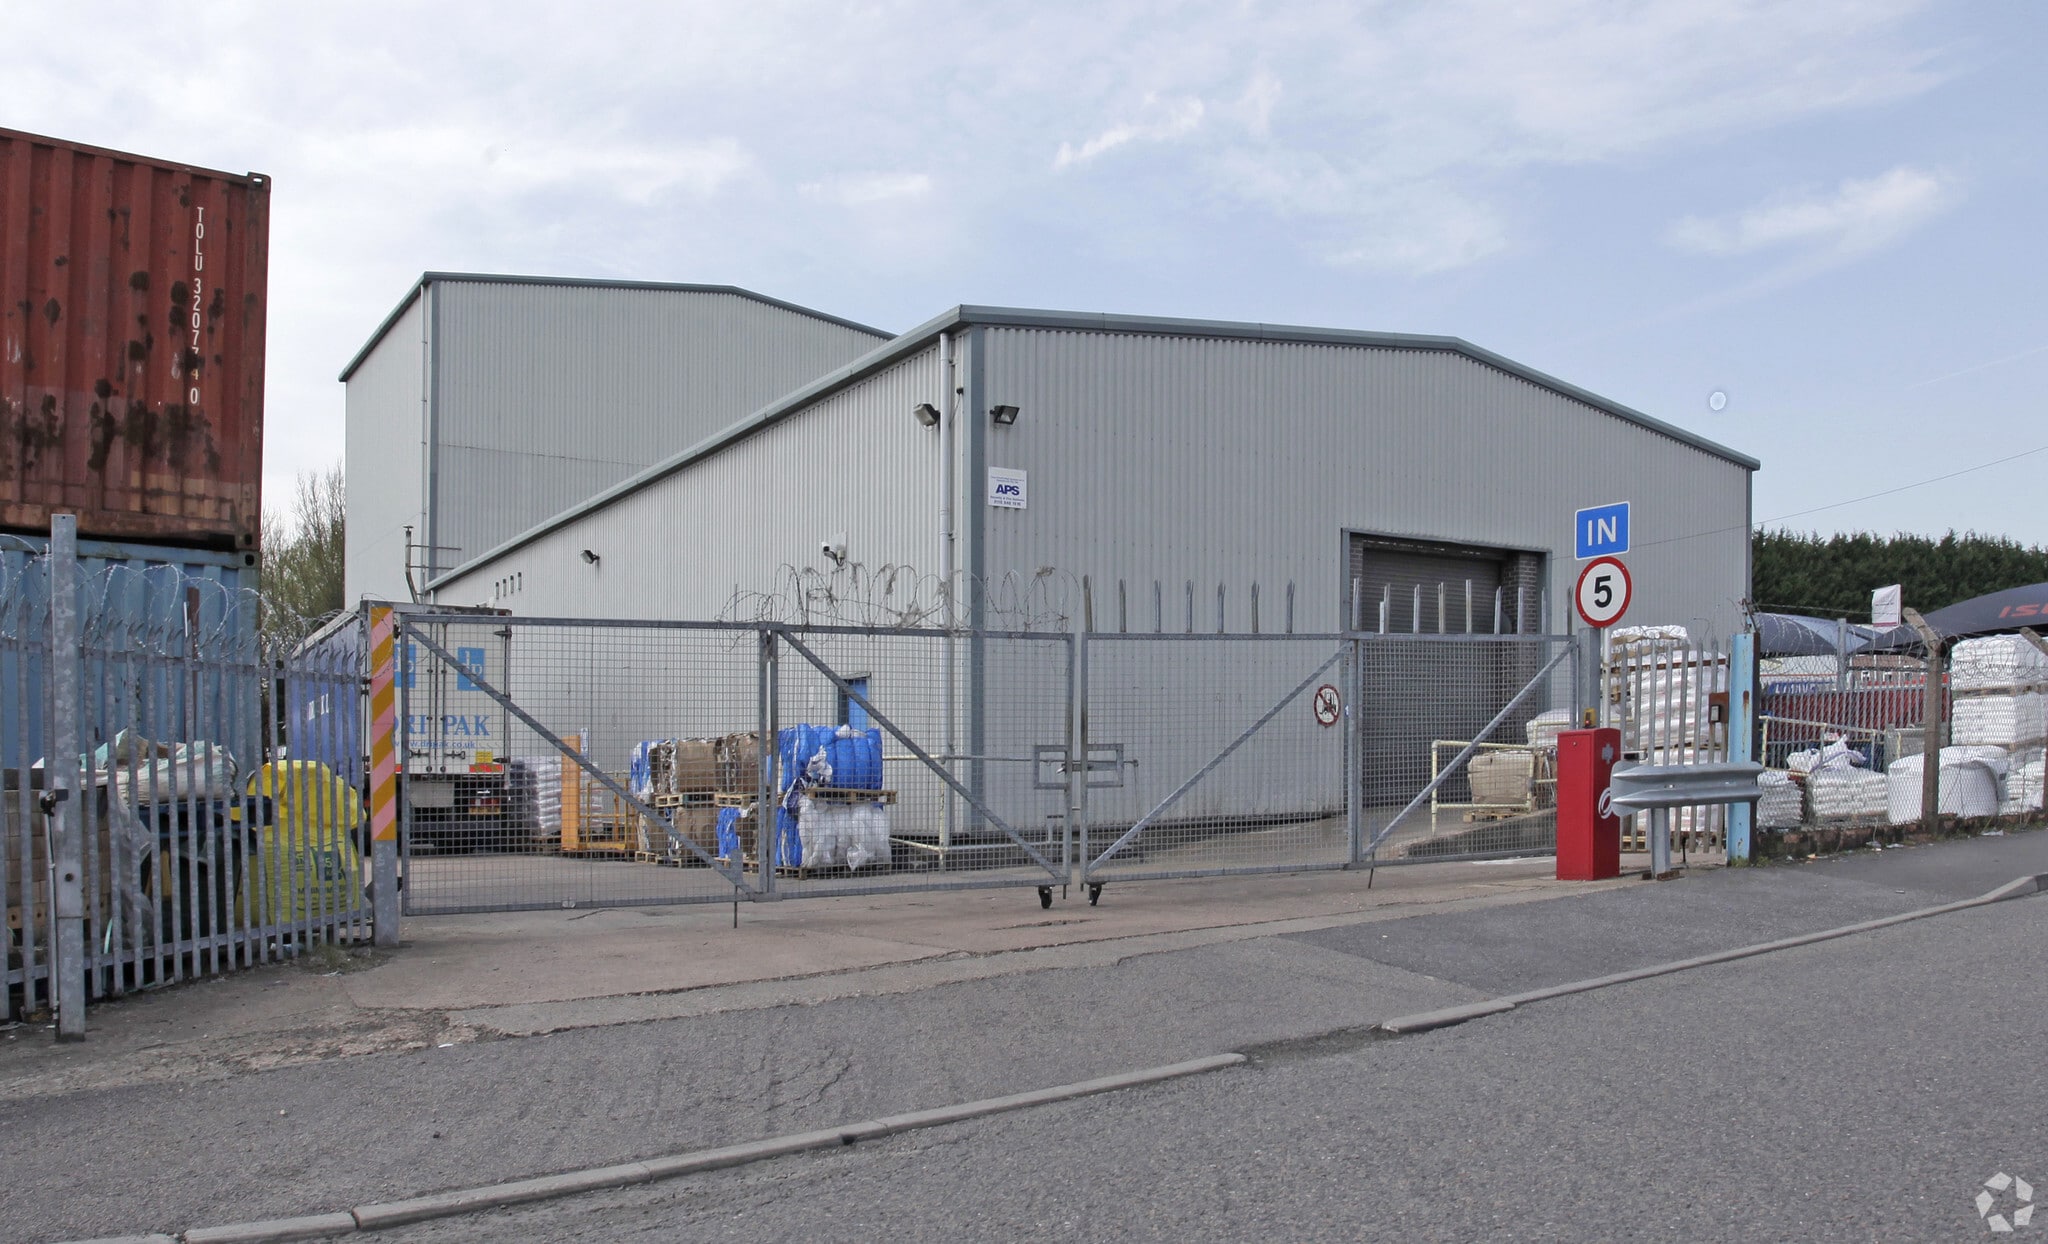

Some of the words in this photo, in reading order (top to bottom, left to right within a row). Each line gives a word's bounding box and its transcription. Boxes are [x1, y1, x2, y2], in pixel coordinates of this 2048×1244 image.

[194, 207, 204, 271] TOLU
[996, 484, 1020, 496] APS
[1587, 516, 1616, 546] IN
[1594, 575, 1613, 608] 5
[443, 714, 491, 736] PAK
